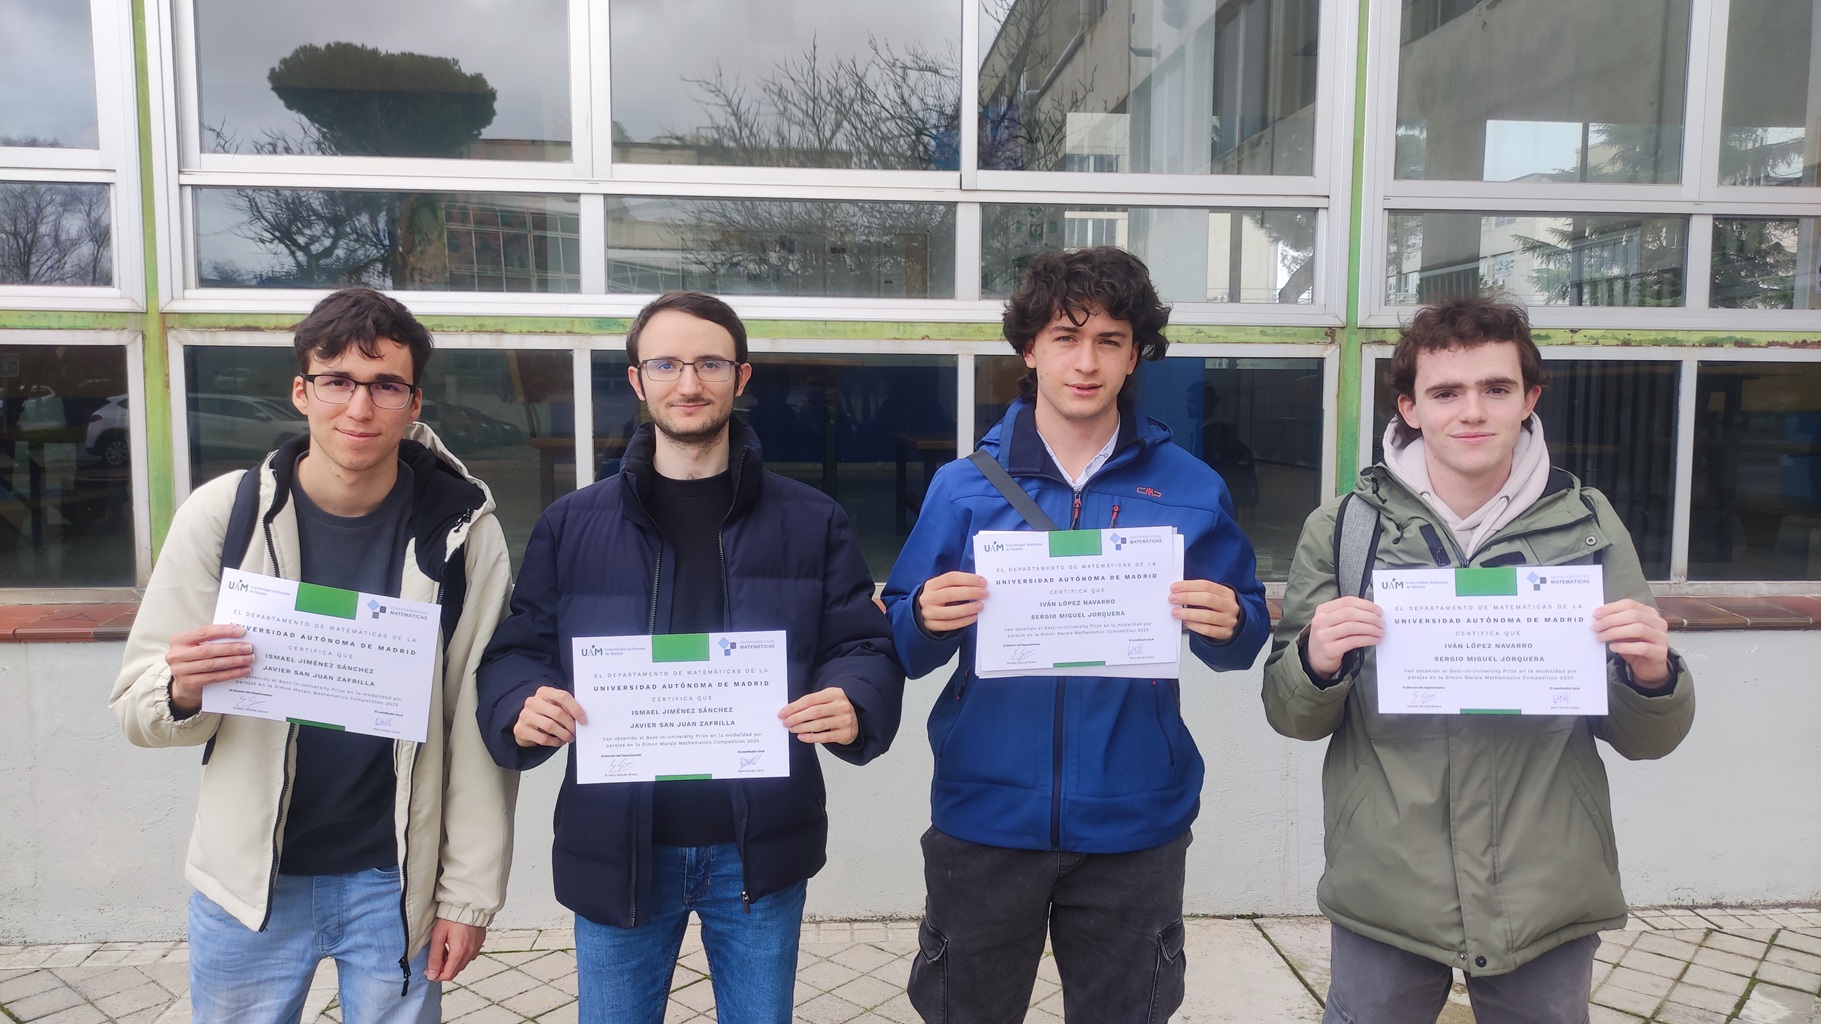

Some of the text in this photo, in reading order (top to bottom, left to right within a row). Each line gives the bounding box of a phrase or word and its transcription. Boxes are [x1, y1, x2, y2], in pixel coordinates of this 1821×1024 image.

[1059, 574, 1105, 582] AUTÓNOMA
[389, 610, 428, 620] MATEMÁTICAS
[246, 611, 310, 627] DEPARTAMENTO
[329, 625, 388, 639] MATEMÁTICAS
[301, 633, 356, 647] AUTÓNOMA
[378, 645, 416, 655] MADRID
[289, 645, 333, 656] CERTIFICA
[266, 653, 374, 674] ISMAEL JIMÉNEZ SÁNCHEZ
[263, 665, 291, 674] JAVIER
[313, 672, 334, 680] JUAN
[337, 676, 375, 686] ZAFRILLA
[593, 684, 657, 692] UNIVERSIDAD
[662, 681, 713, 689] AUTÓNOMA
[662, 707, 695, 715] JIMÉNEZ
